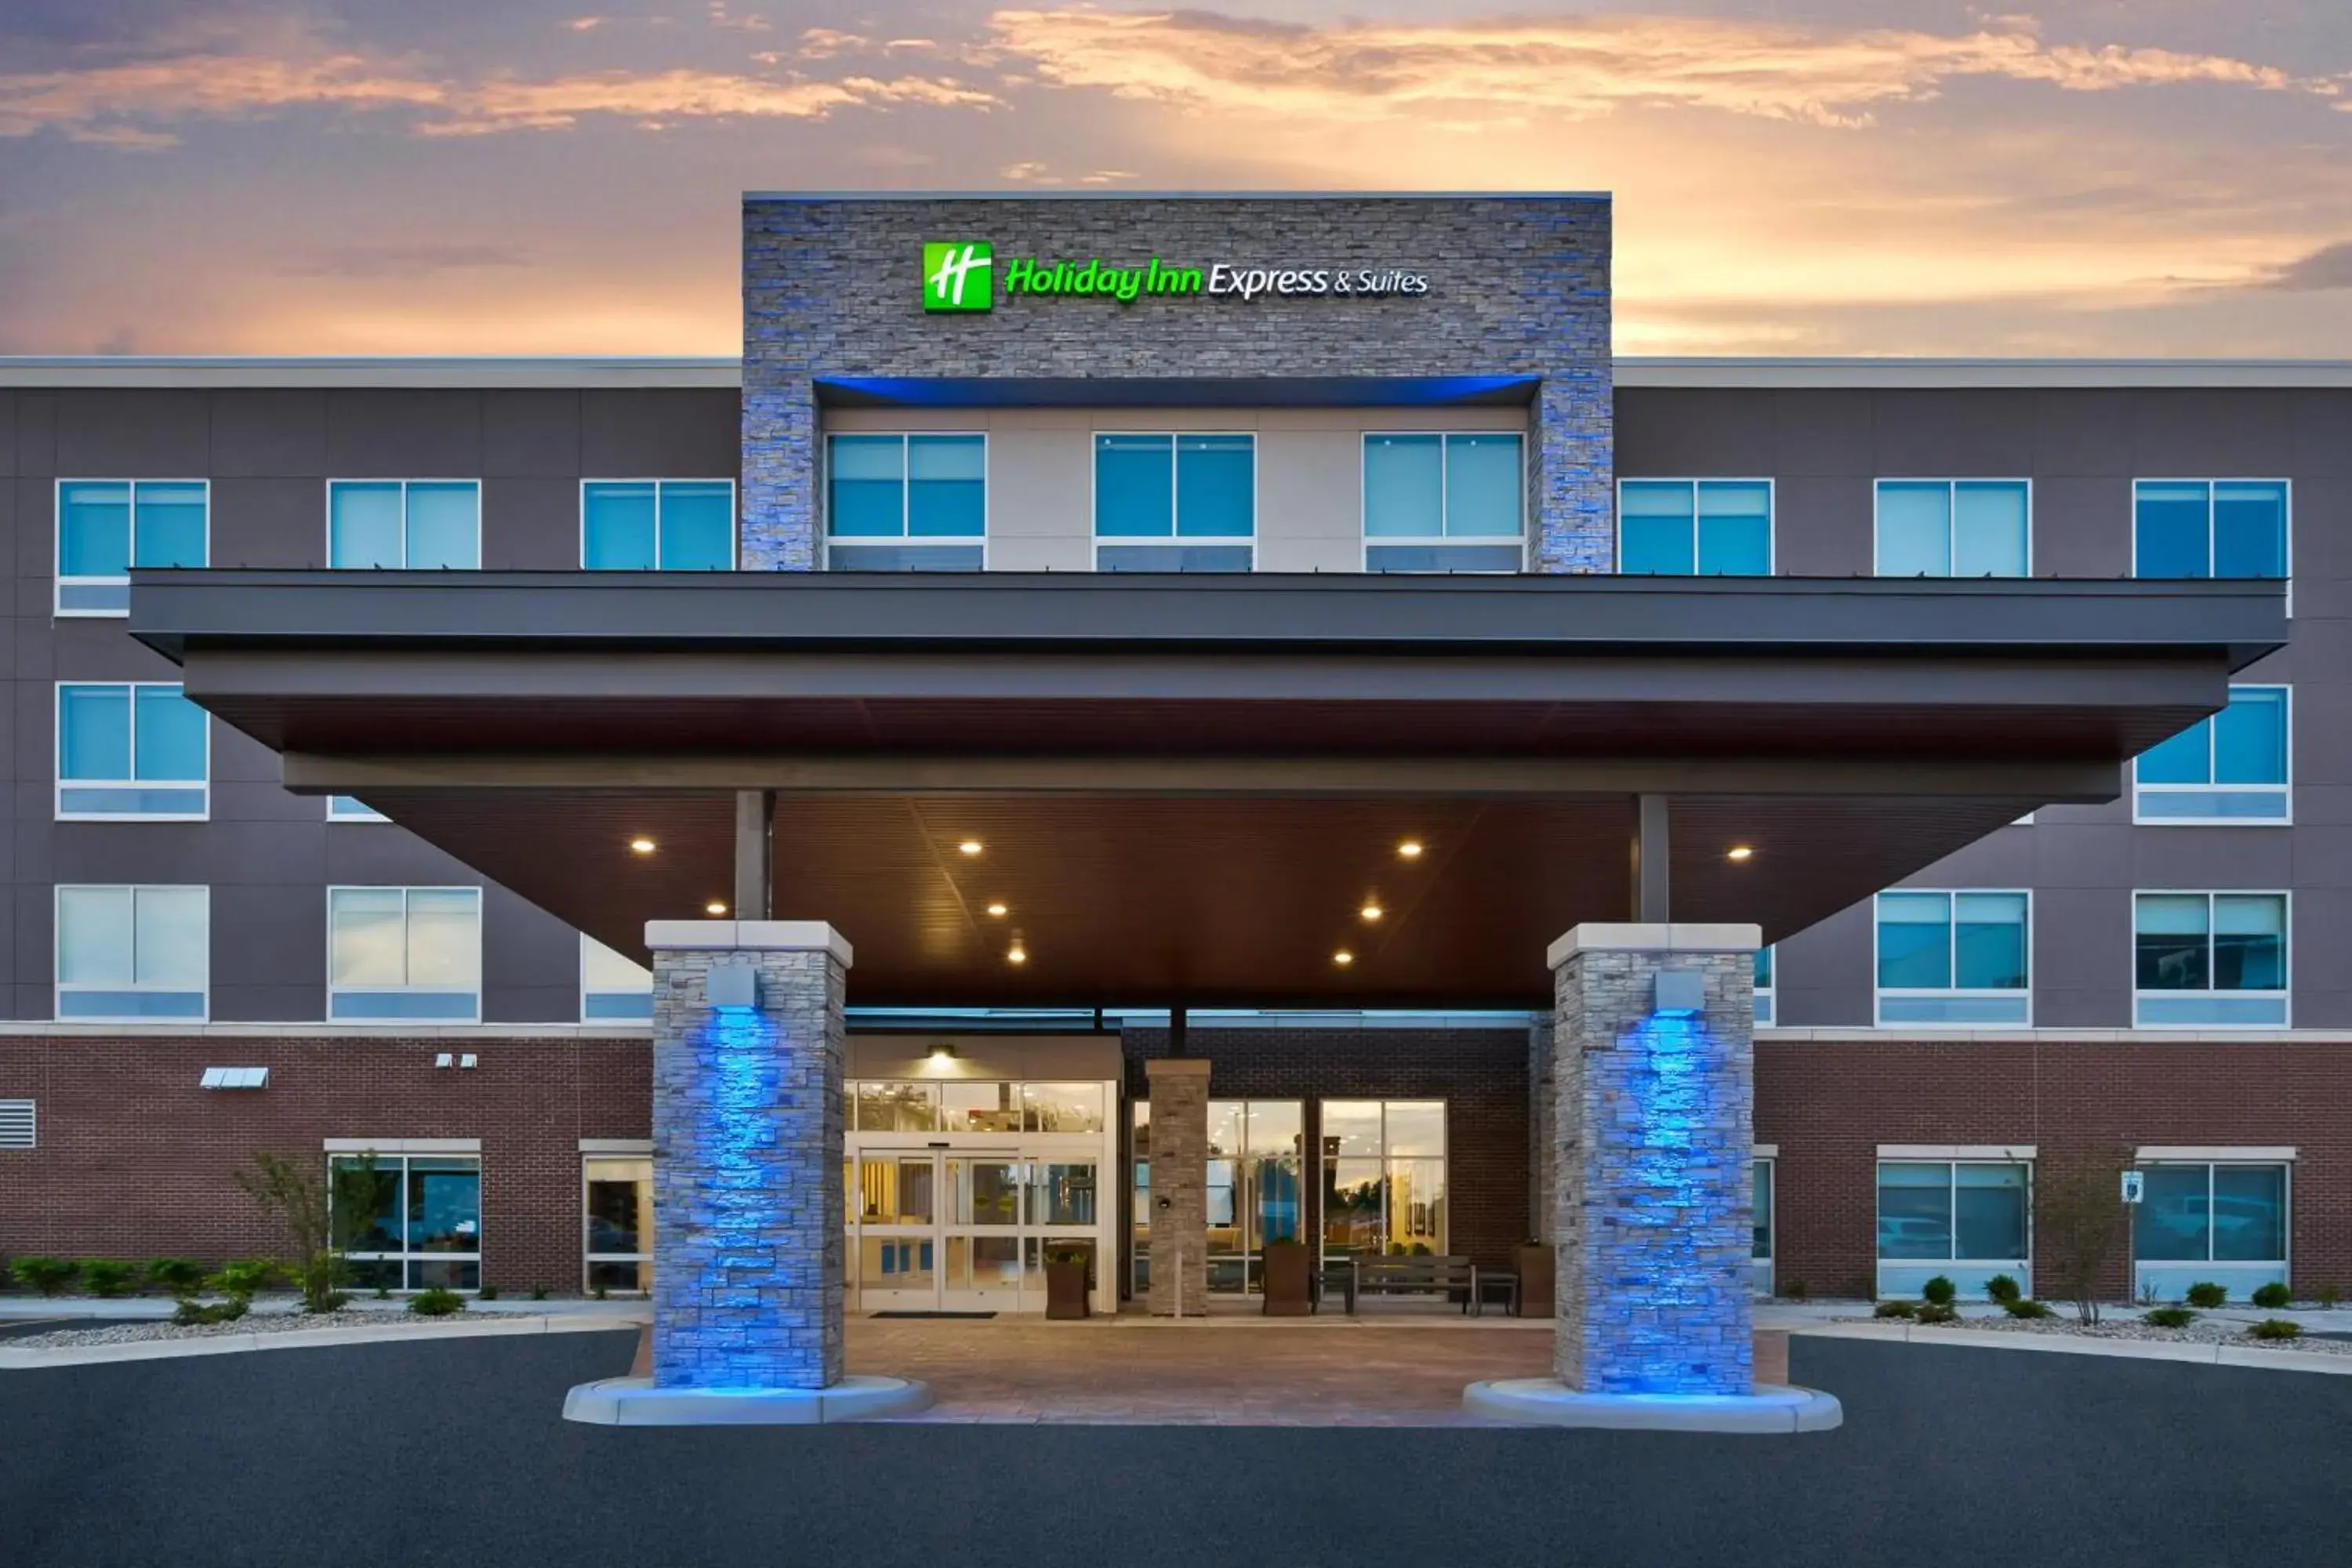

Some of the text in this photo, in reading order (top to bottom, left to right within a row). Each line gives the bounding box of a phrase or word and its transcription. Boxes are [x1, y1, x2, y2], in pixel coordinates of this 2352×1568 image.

[1006, 256, 1428, 300] Holiday Inn Express & Suites
